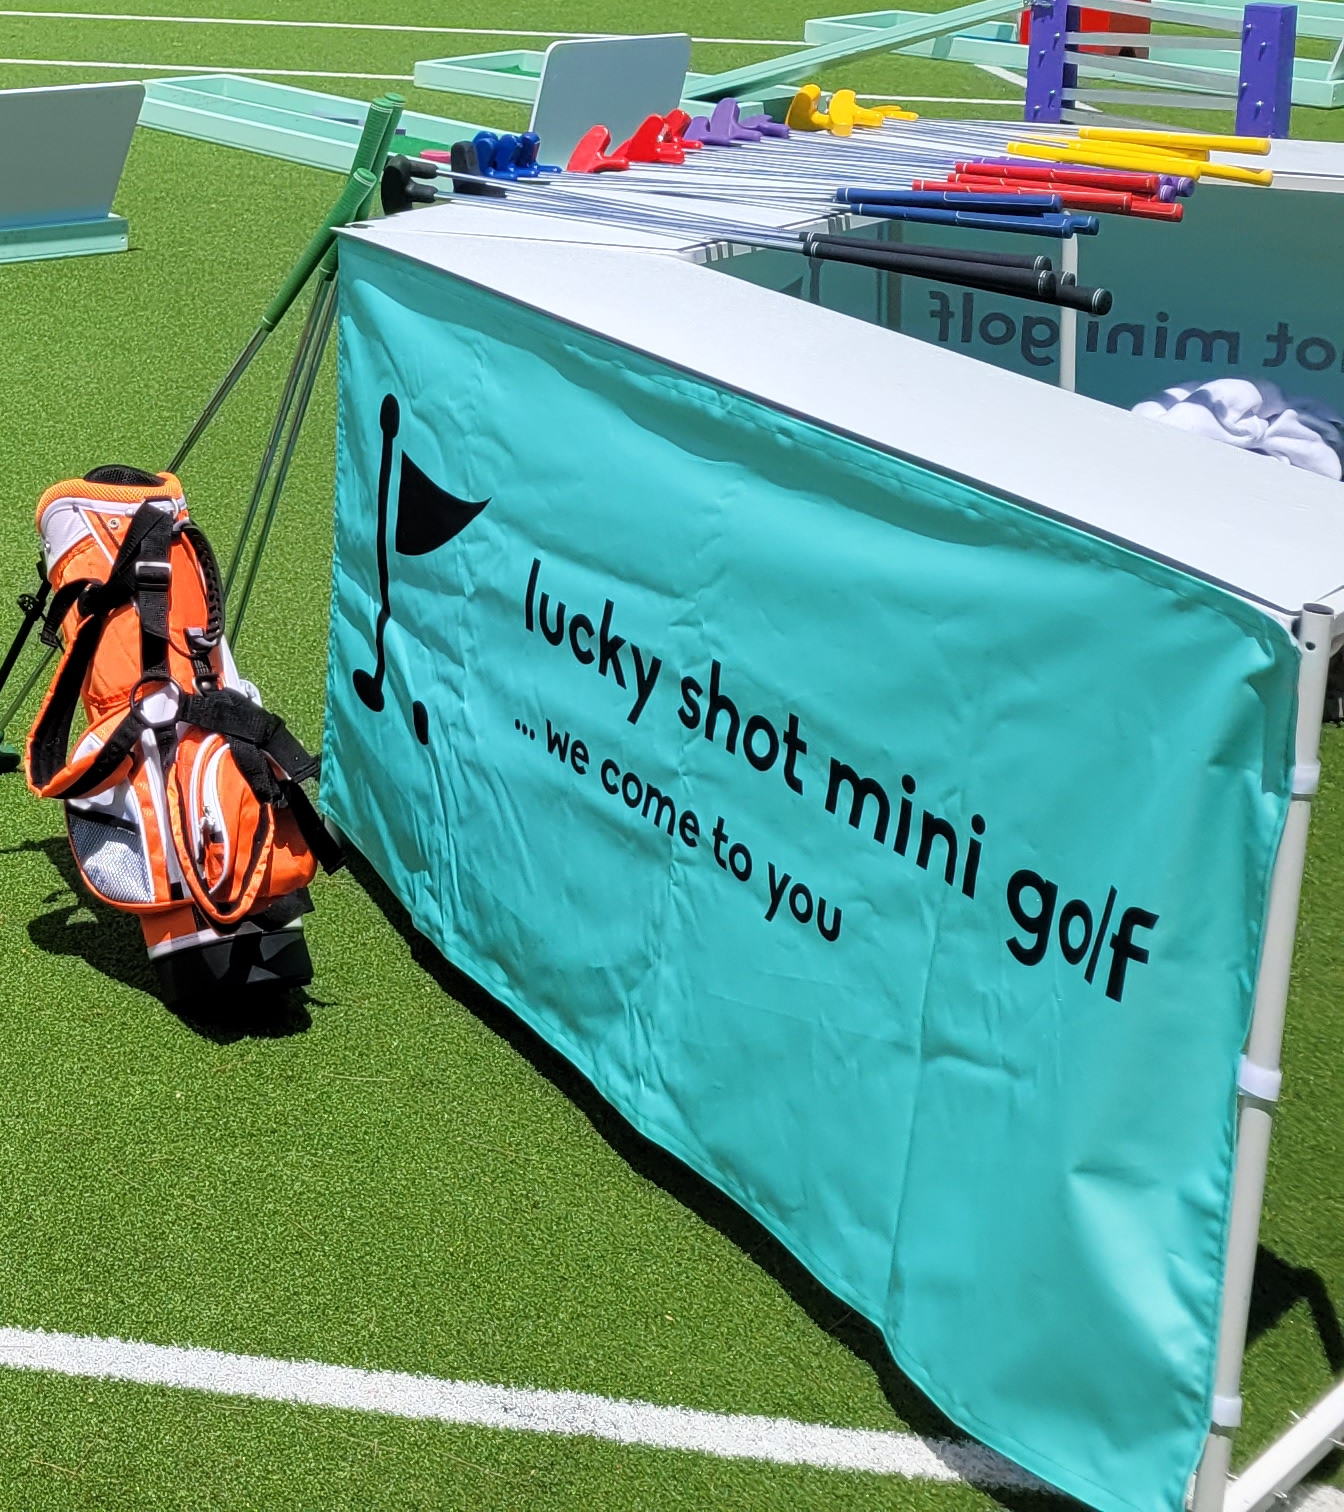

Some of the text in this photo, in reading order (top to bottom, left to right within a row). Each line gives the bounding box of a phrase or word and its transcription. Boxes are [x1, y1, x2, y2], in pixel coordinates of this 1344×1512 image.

[525, 557, 1161, 1004] lucky shot mini golf
[545, 718, 590, 776] we
[600, 757, 700, 848] come
[712, 816, 753, 882] to
[764, 862, 843, 943] you
